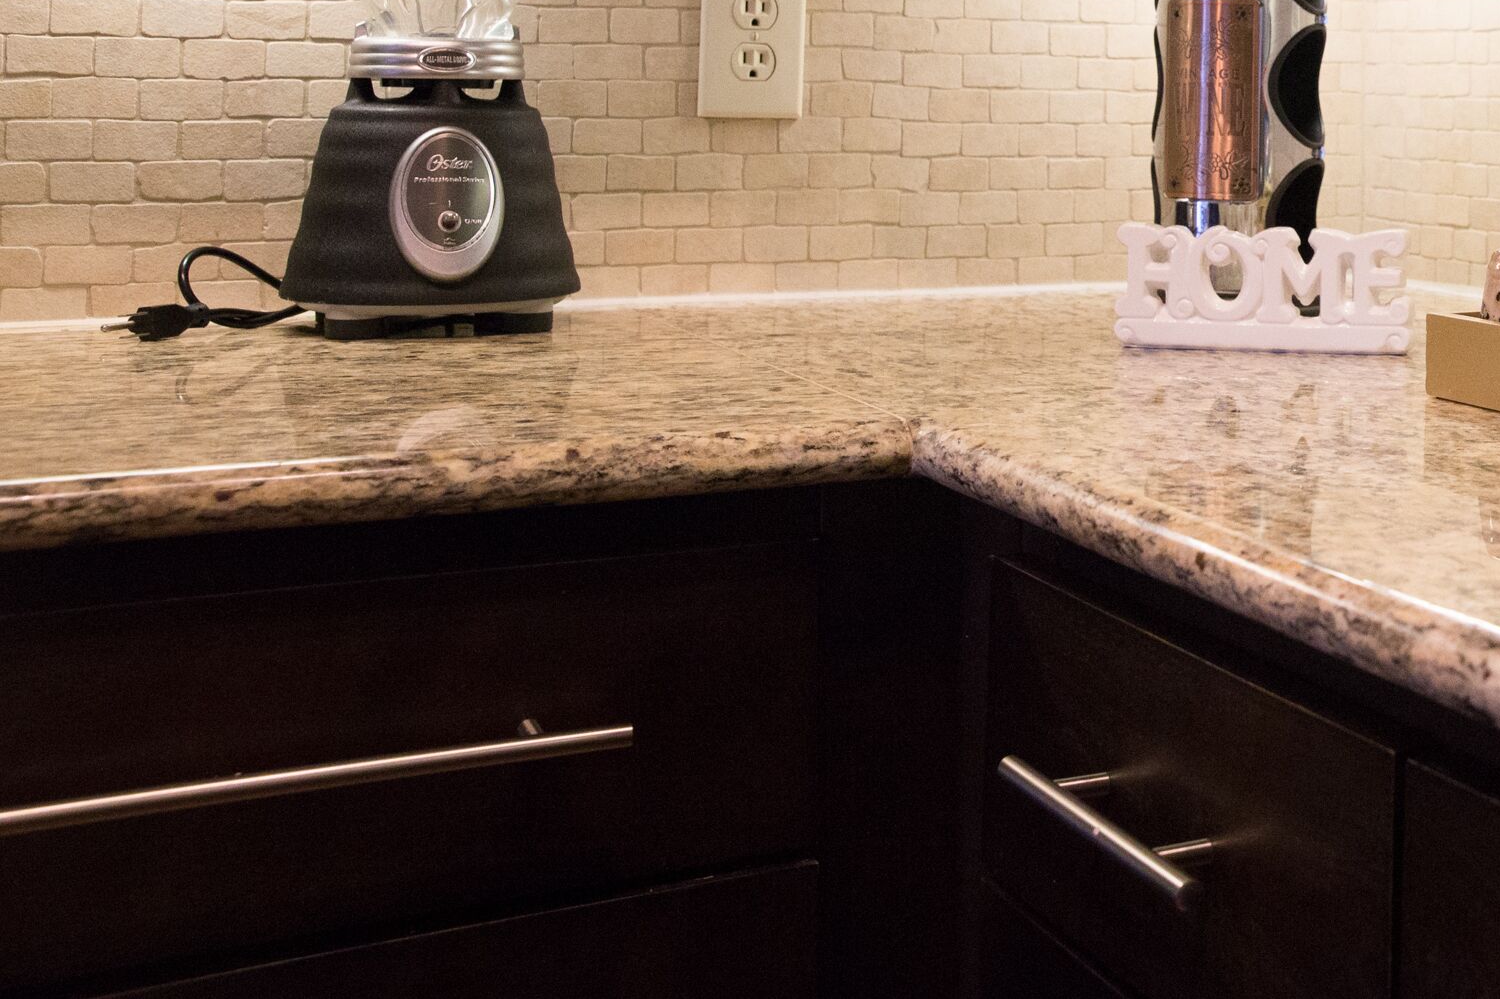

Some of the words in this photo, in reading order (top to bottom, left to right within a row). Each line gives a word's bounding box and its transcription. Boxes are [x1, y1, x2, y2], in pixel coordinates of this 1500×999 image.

[1174, 68, 1240, 80] VINAGE
[1173, 81, 1247, 137] WNE
[427, 153, 472, 172] Oster
[1115, 222, 1410, 326] HOME
